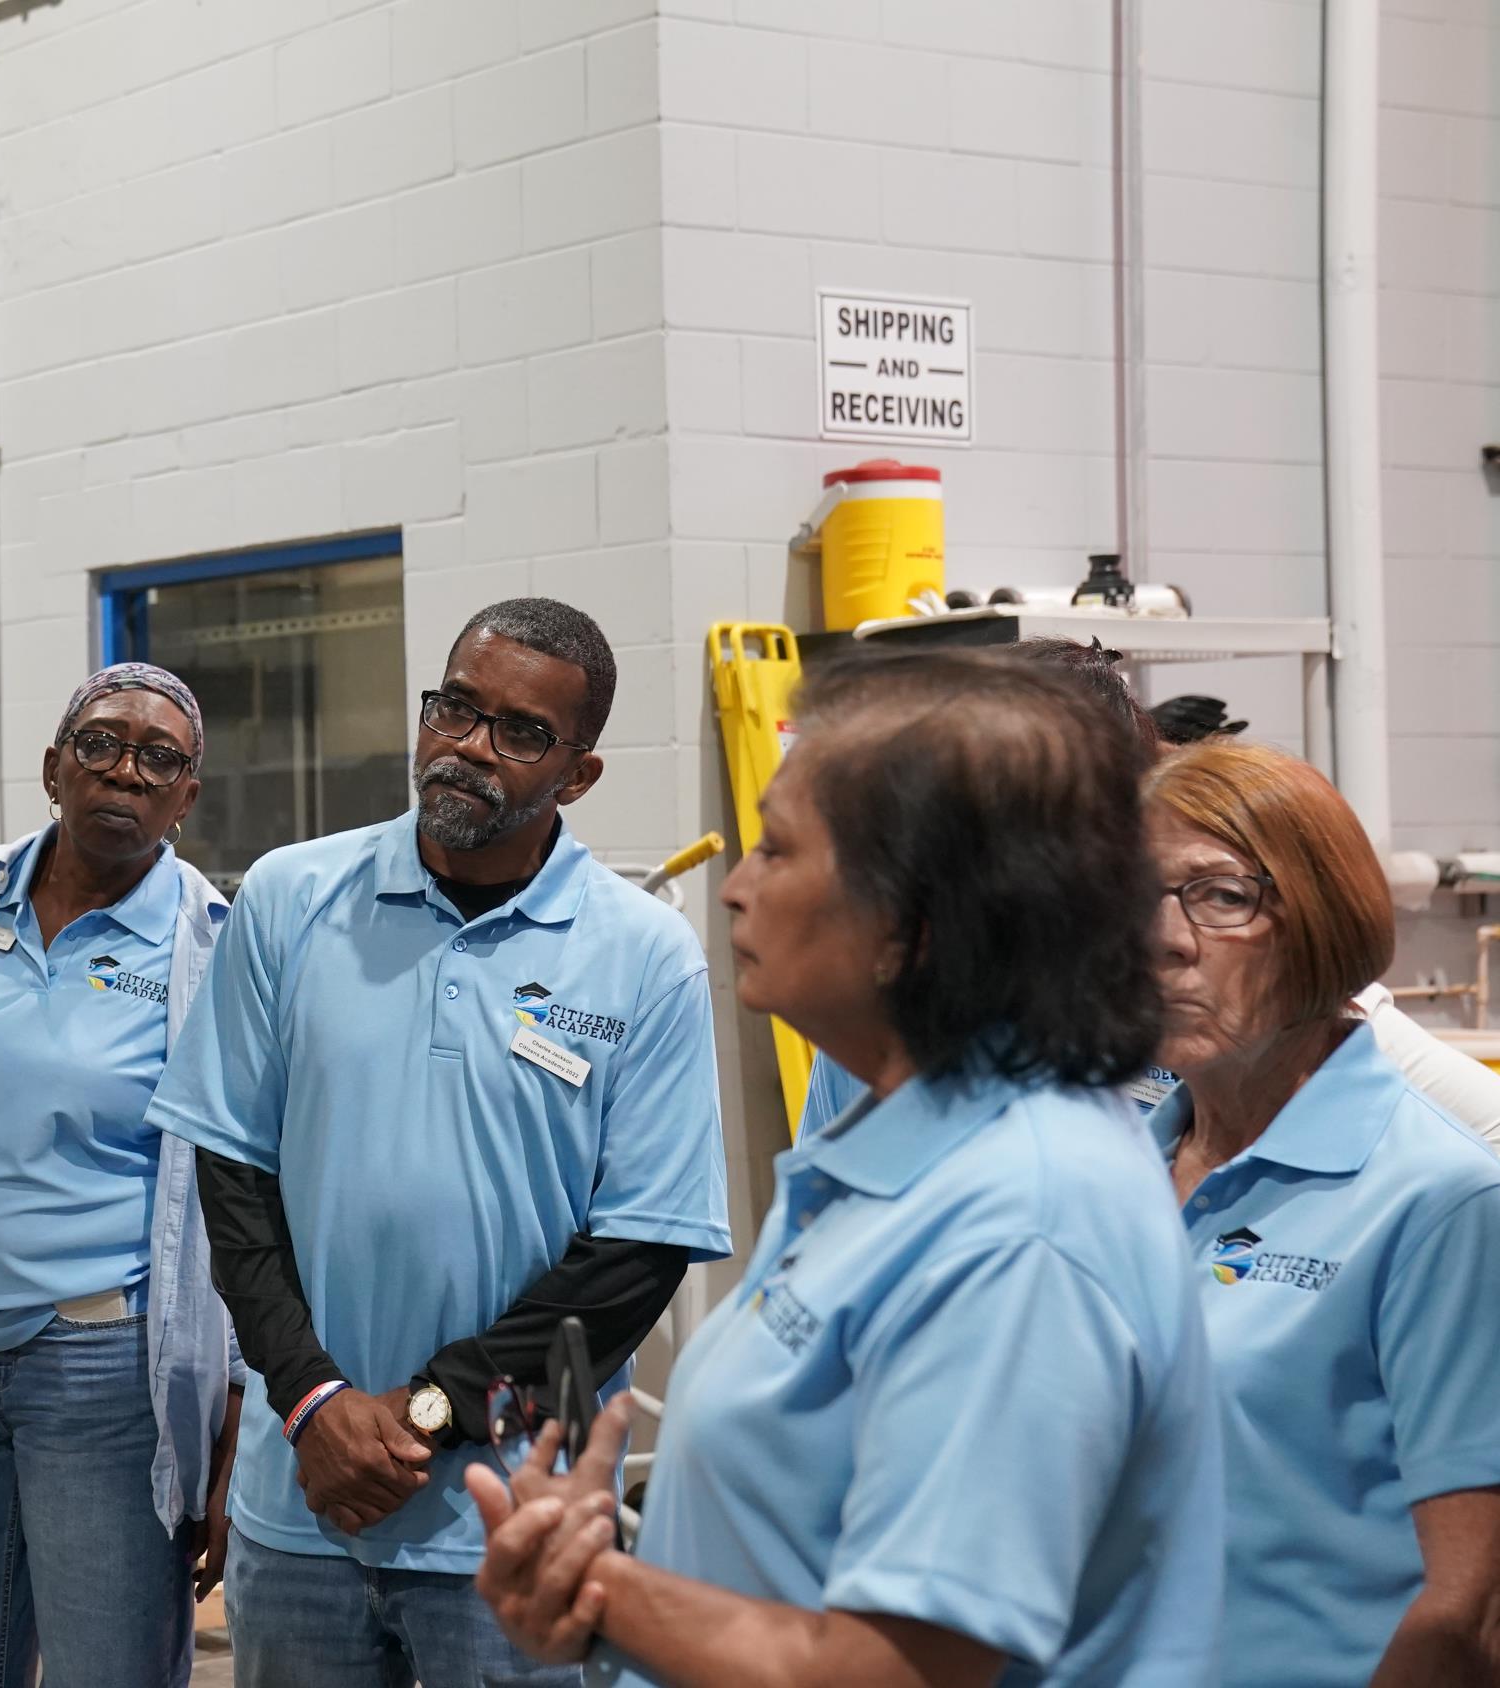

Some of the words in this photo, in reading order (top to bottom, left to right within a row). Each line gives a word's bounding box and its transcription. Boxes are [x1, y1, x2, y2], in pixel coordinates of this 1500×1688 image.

[838, 307, 954, 344] SHIPPING
[877, 357, 919, 378] AND
[831, 391, 963, 428] RECEIVING
[113, 981, 168, 1006] ACADEM
[117, 972, 169, 996] CITIZEN
[545, 1016, 623, 1045] ACADEMY
[549, 1004, 626, 1034] CITIZENS
[518, 1042, 540, 1059] Citizens
[540, 1055, 565, 1072] Academy
[565, 1067, 580, 1079] 2022
[531, 1039, 551, 1055] Charles
[551, 1051, 573, 1066] Jackson
